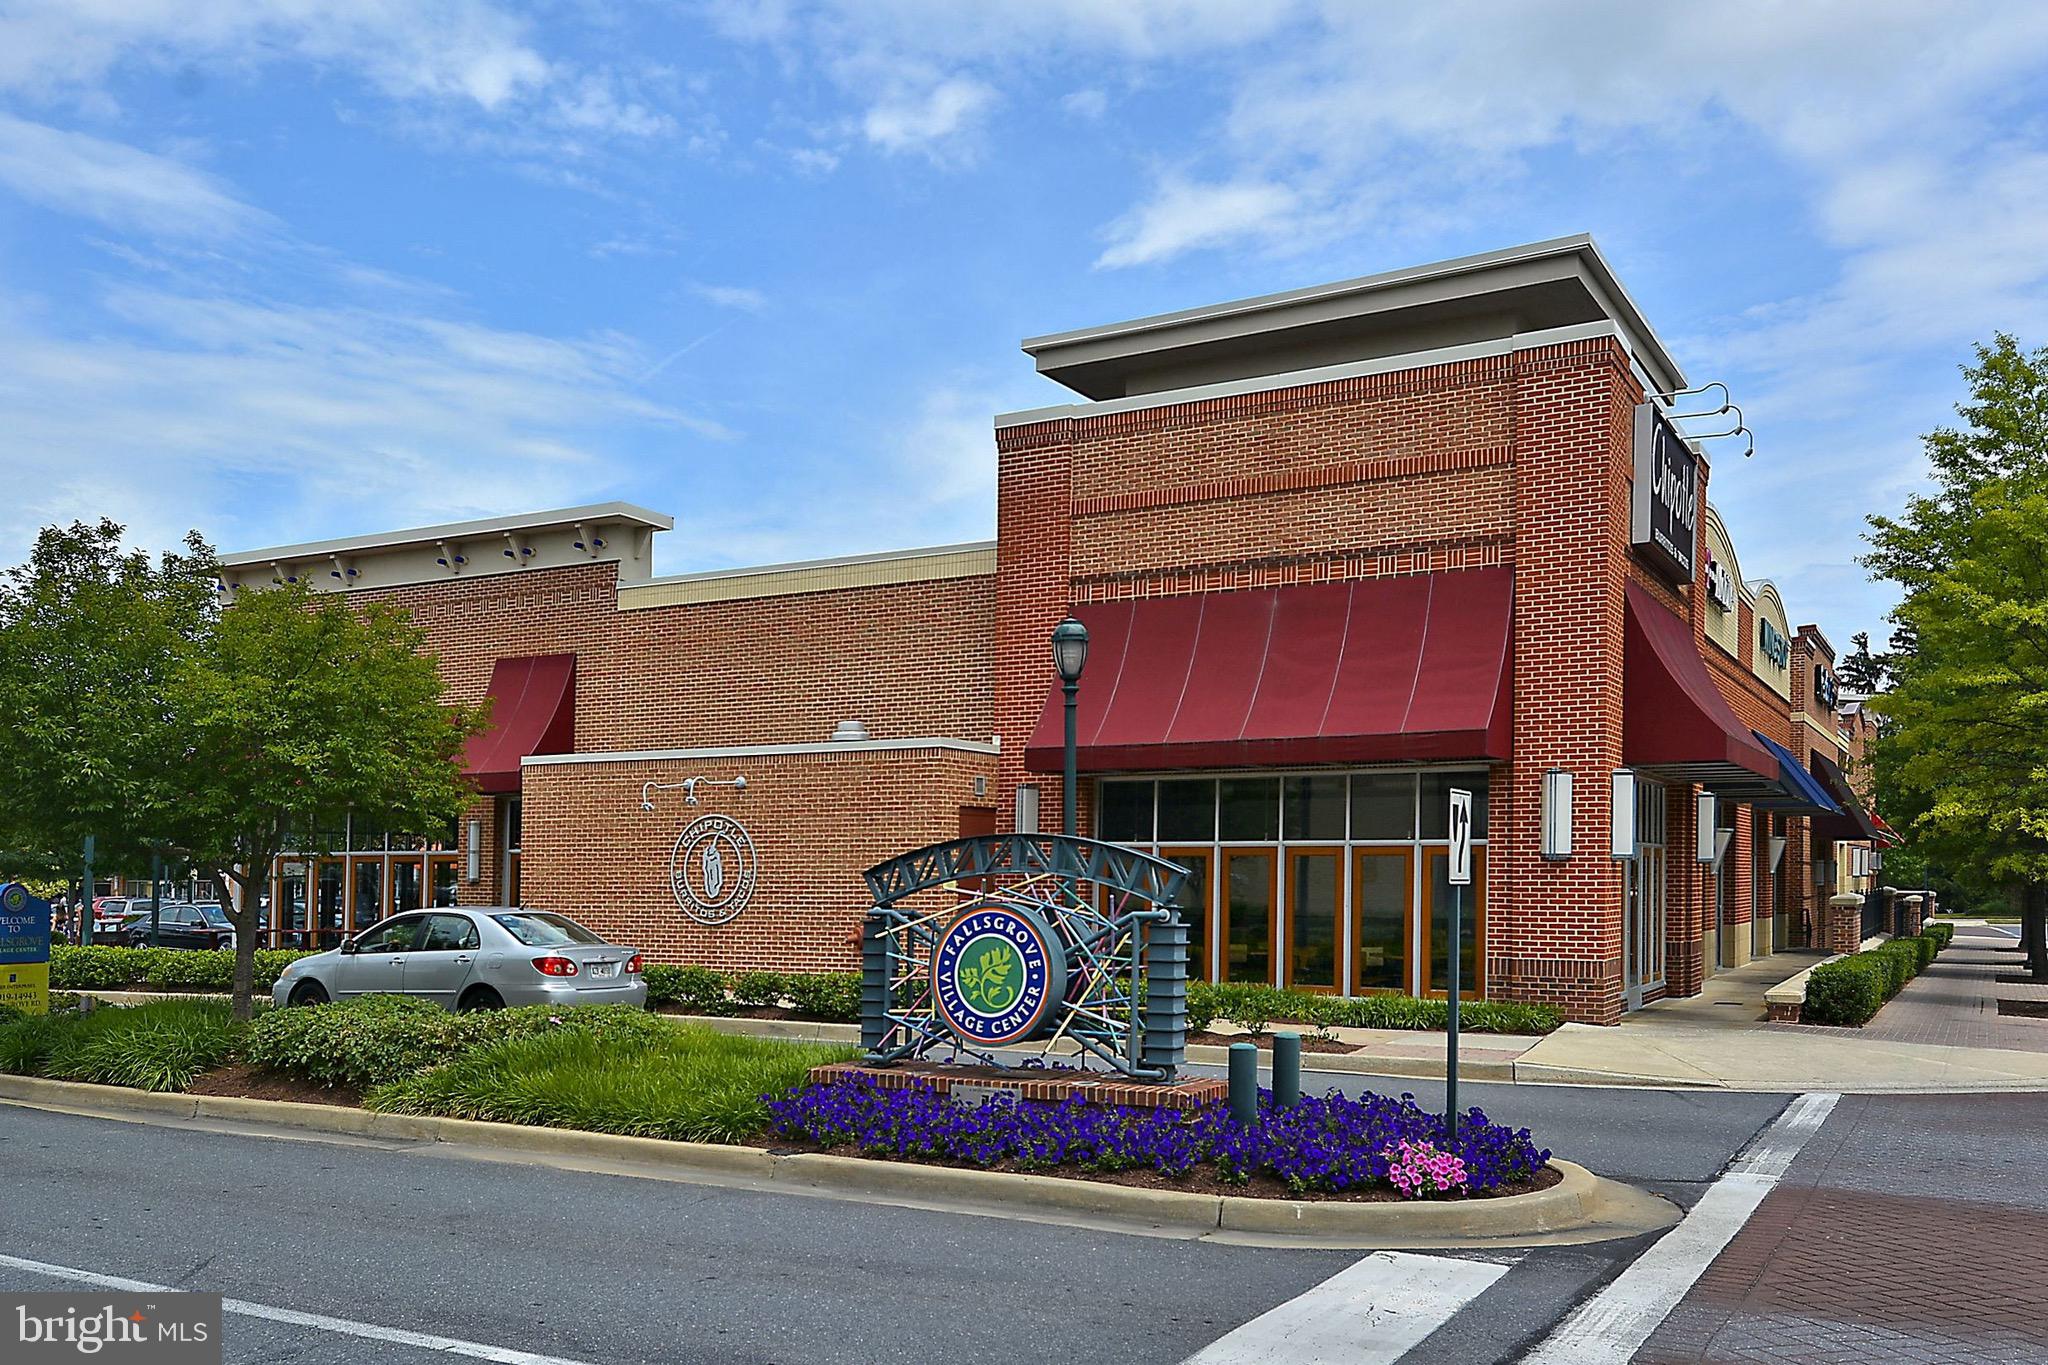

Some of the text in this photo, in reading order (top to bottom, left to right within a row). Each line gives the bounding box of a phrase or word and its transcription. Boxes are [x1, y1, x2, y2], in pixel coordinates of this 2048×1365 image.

[1653, 422, 1694, 535] Chipotle
[681, 819, 746, 848] CHIPOTLE
[675, 870, 751, 918] BURRITOS & TACOS
[8, 924, 21, 933] TO
[944, 916, 1042, 970] FALLSGROVE
[939, 971, 1041, 1034] VILLAGE CENTER
